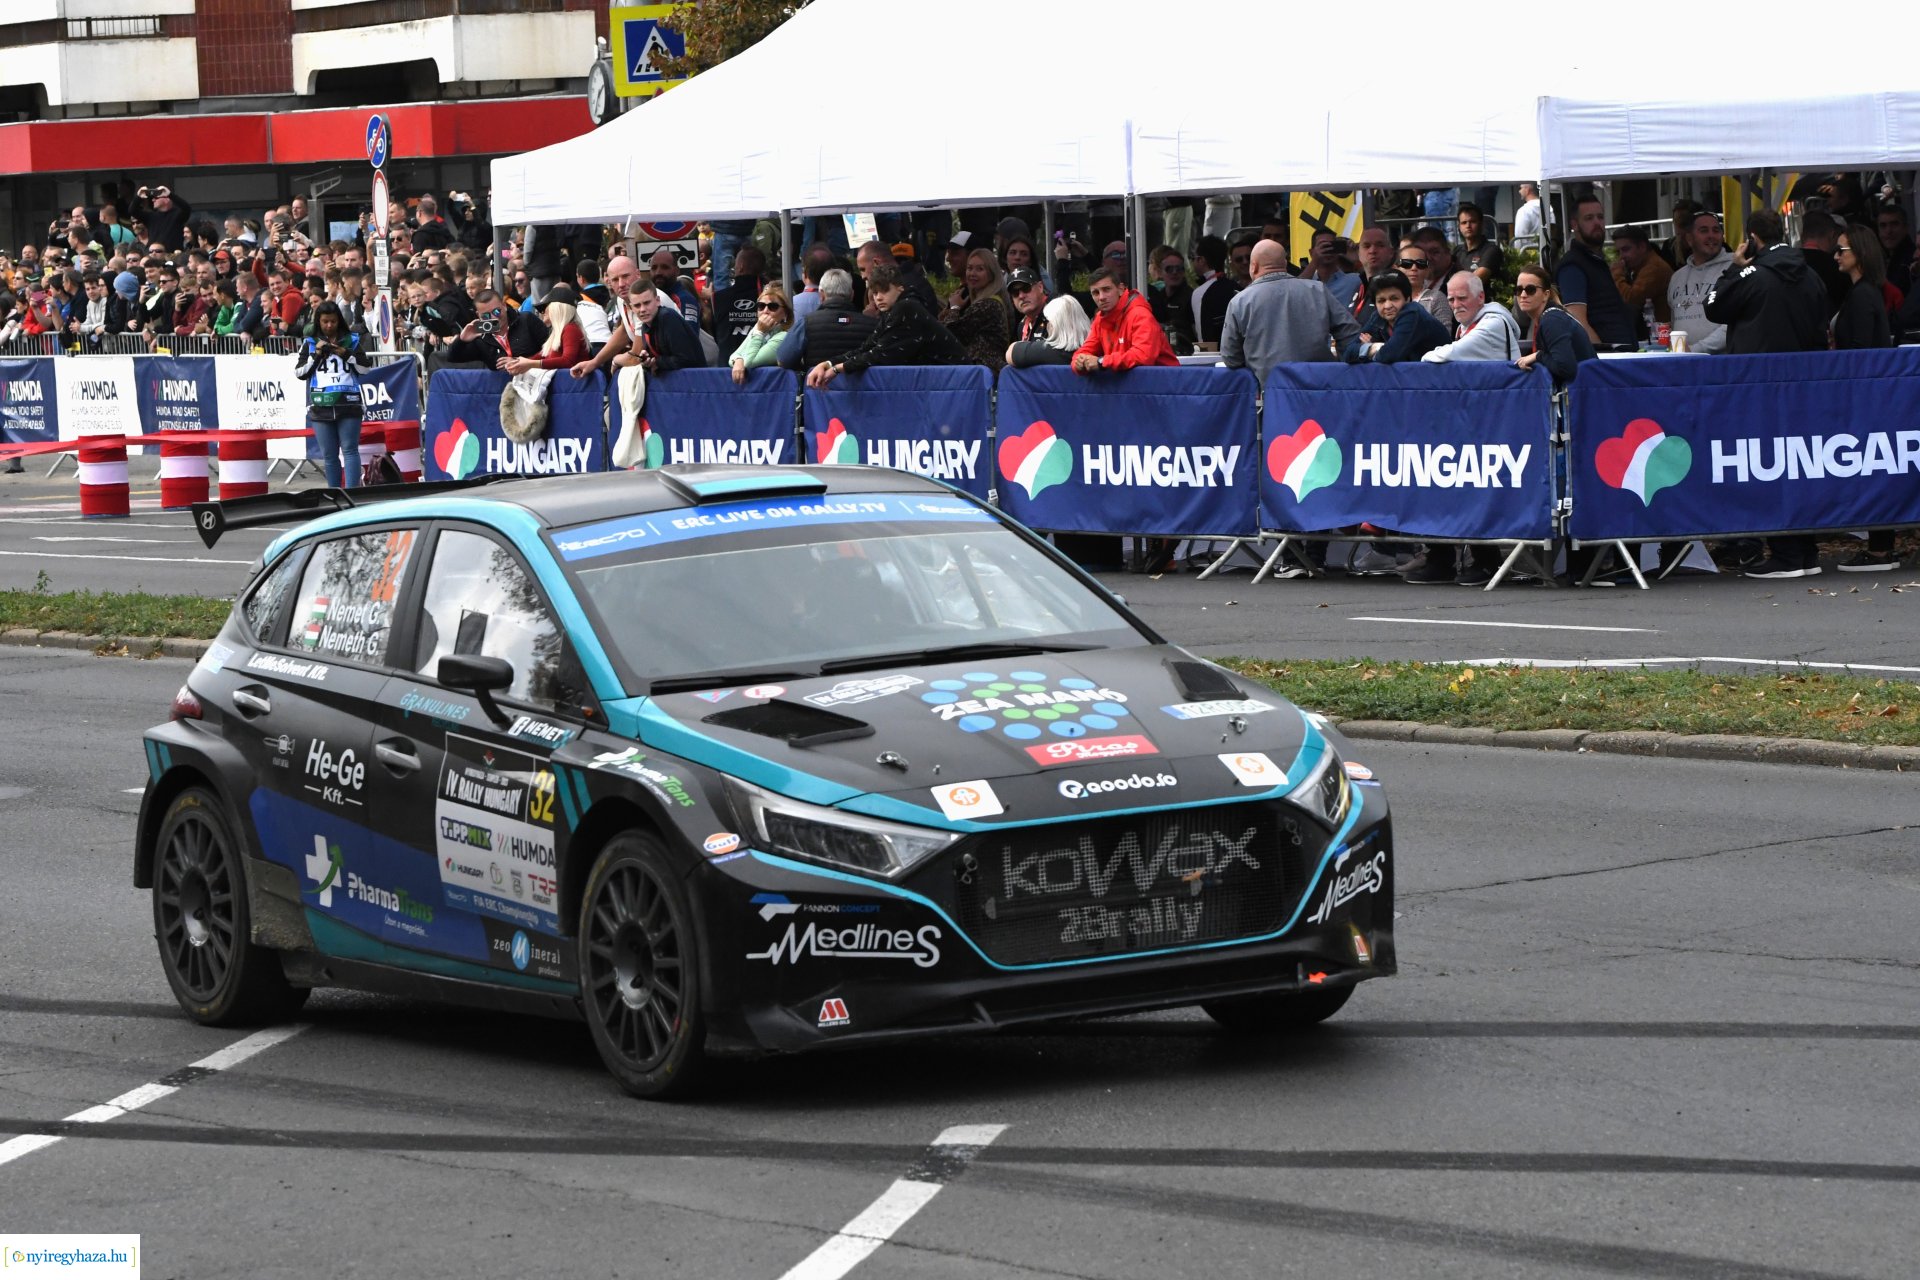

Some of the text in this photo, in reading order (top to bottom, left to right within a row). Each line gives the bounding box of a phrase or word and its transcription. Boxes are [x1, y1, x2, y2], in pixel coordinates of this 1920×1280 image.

[10, 380, 44, 402] HUMDA
[80, 380, 119, 401] HUMDA
[161, 379, 199, 402] HUMDA
[246, 381, 286, 402] HUMDA
[331, 376, 341, 384] TV
[366, 408, 395, 421] SAFETY
[486, 437, 593, 474] HUNGARY
[669, 437, 785, 465] HUNGARY
[866, 438, 982, 480] HUNGARY
[1082, 444, 1241, 488] HUNGARY
[1353, 443, 1532, 488] HUNGARY
[671, 502, 887, 530] ERC LIVE ON RALLY.TV
[930, 697, 1016, 721] ZEA
[304, 737, 366, 791] He-Ge
[322, 785, 345, 805] Kft.
[457, 776, 485, 805] RALLY
[483, 786, 523, 815] HUNGARY
[530, 769, 556, 823] 32
[511, 836, 558, 869] HUMDA
[493, 938, 511, 953] zeo
